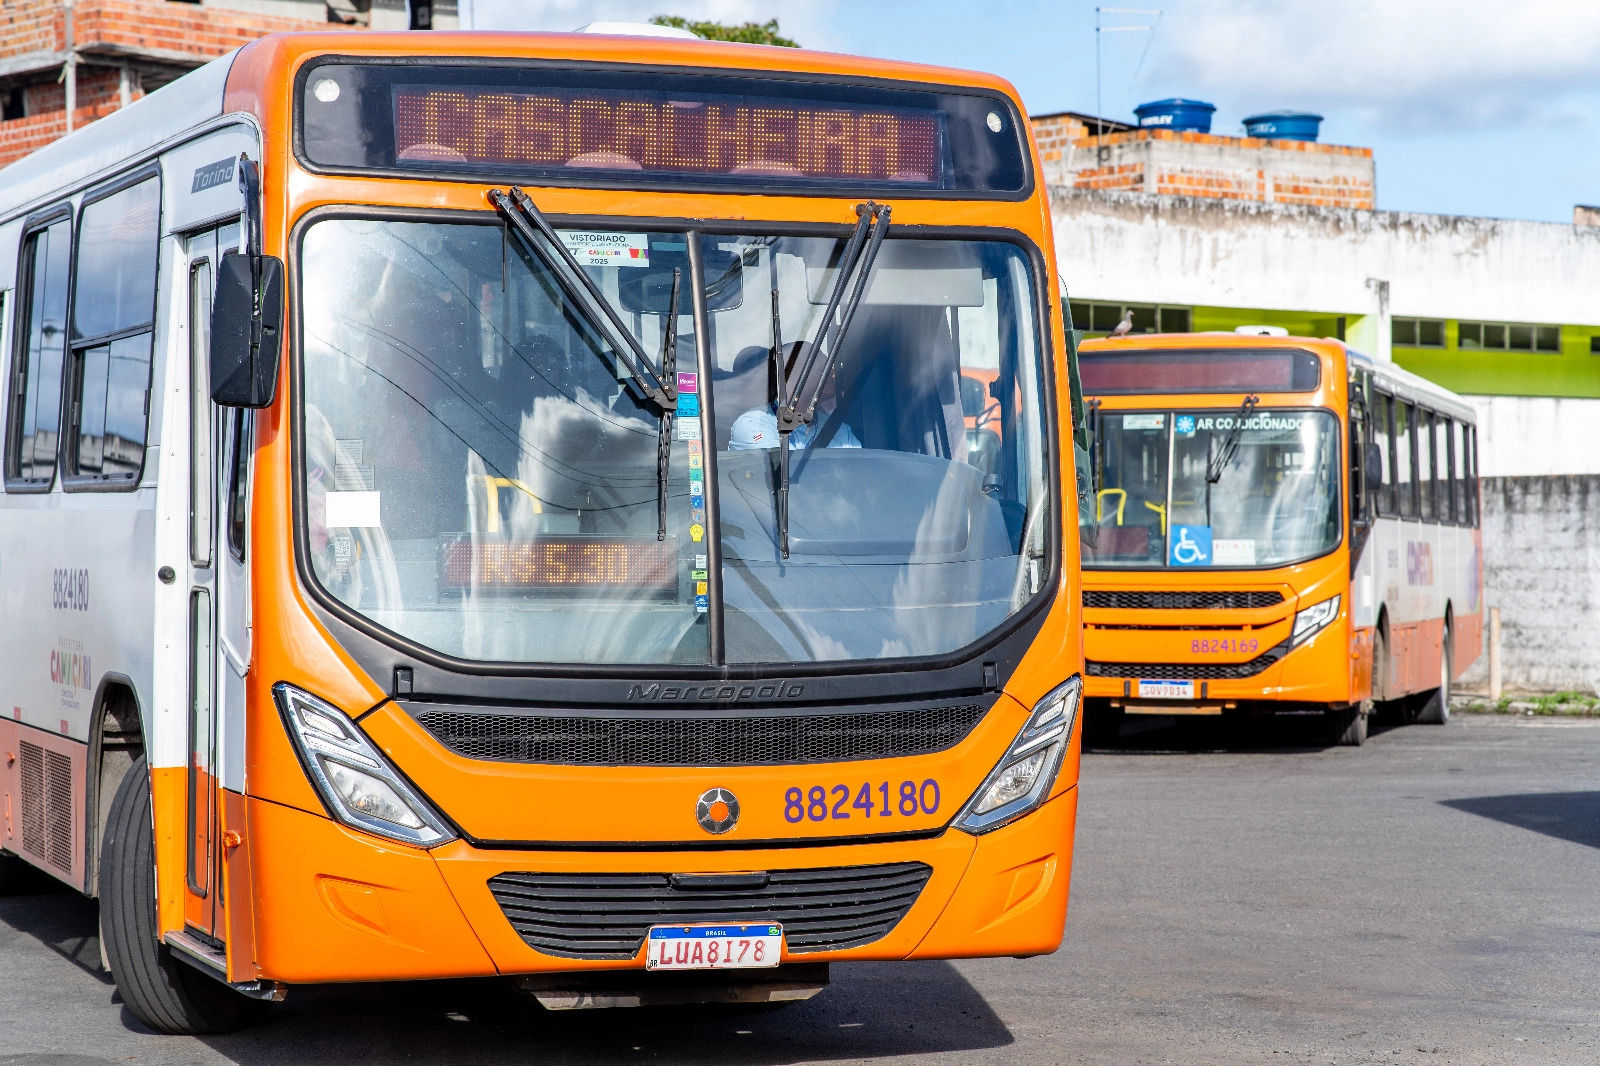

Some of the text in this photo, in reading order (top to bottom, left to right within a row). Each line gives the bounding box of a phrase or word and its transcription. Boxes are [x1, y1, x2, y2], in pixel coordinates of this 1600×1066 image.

[425, 92, 899, 175] CASCALHEIRA
[194, 165, 234, 190] Torino
[569, 234, 626, 243] VISTORIADO
[1196, 418, 1214, 430] AR
[53, 568, 89, 611] 8824180
[1191, 639, 1258, 653] 8824169
[627, 680, 805, 702] Marcopolo
[784, 778, 941, 824] 8824180
